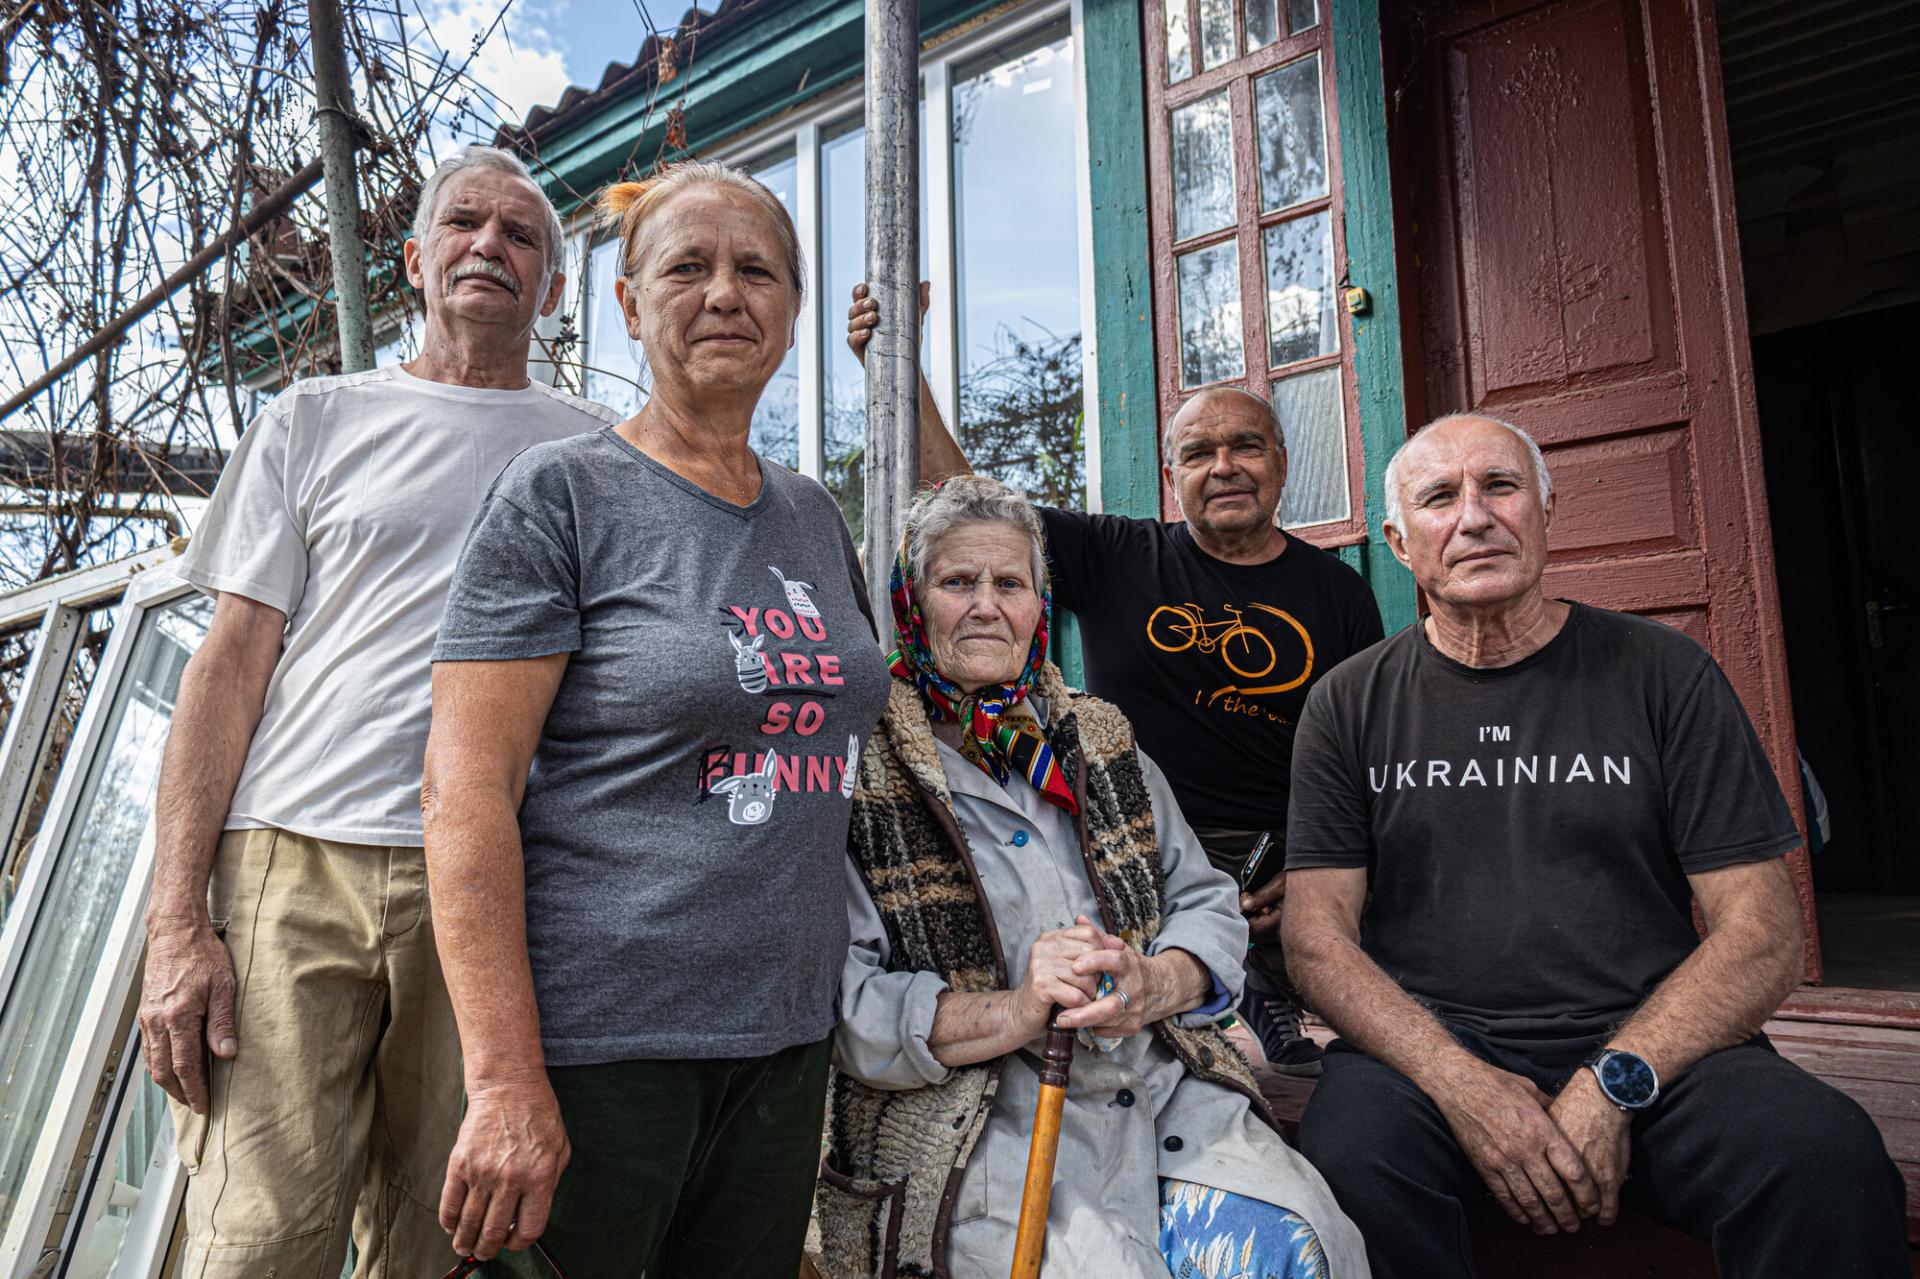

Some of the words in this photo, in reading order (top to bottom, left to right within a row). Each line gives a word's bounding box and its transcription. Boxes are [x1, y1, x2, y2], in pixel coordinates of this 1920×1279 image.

[727, 605, 828, 642] YOU
[757, 651, 845, 686] ARE
[759, 701, 826, 737] SO
[1223, 695, 1260, 717] the
[1479, 725, 1511, 742] I'M
[1369, 753, 1631, 793] UKRAINIAN
